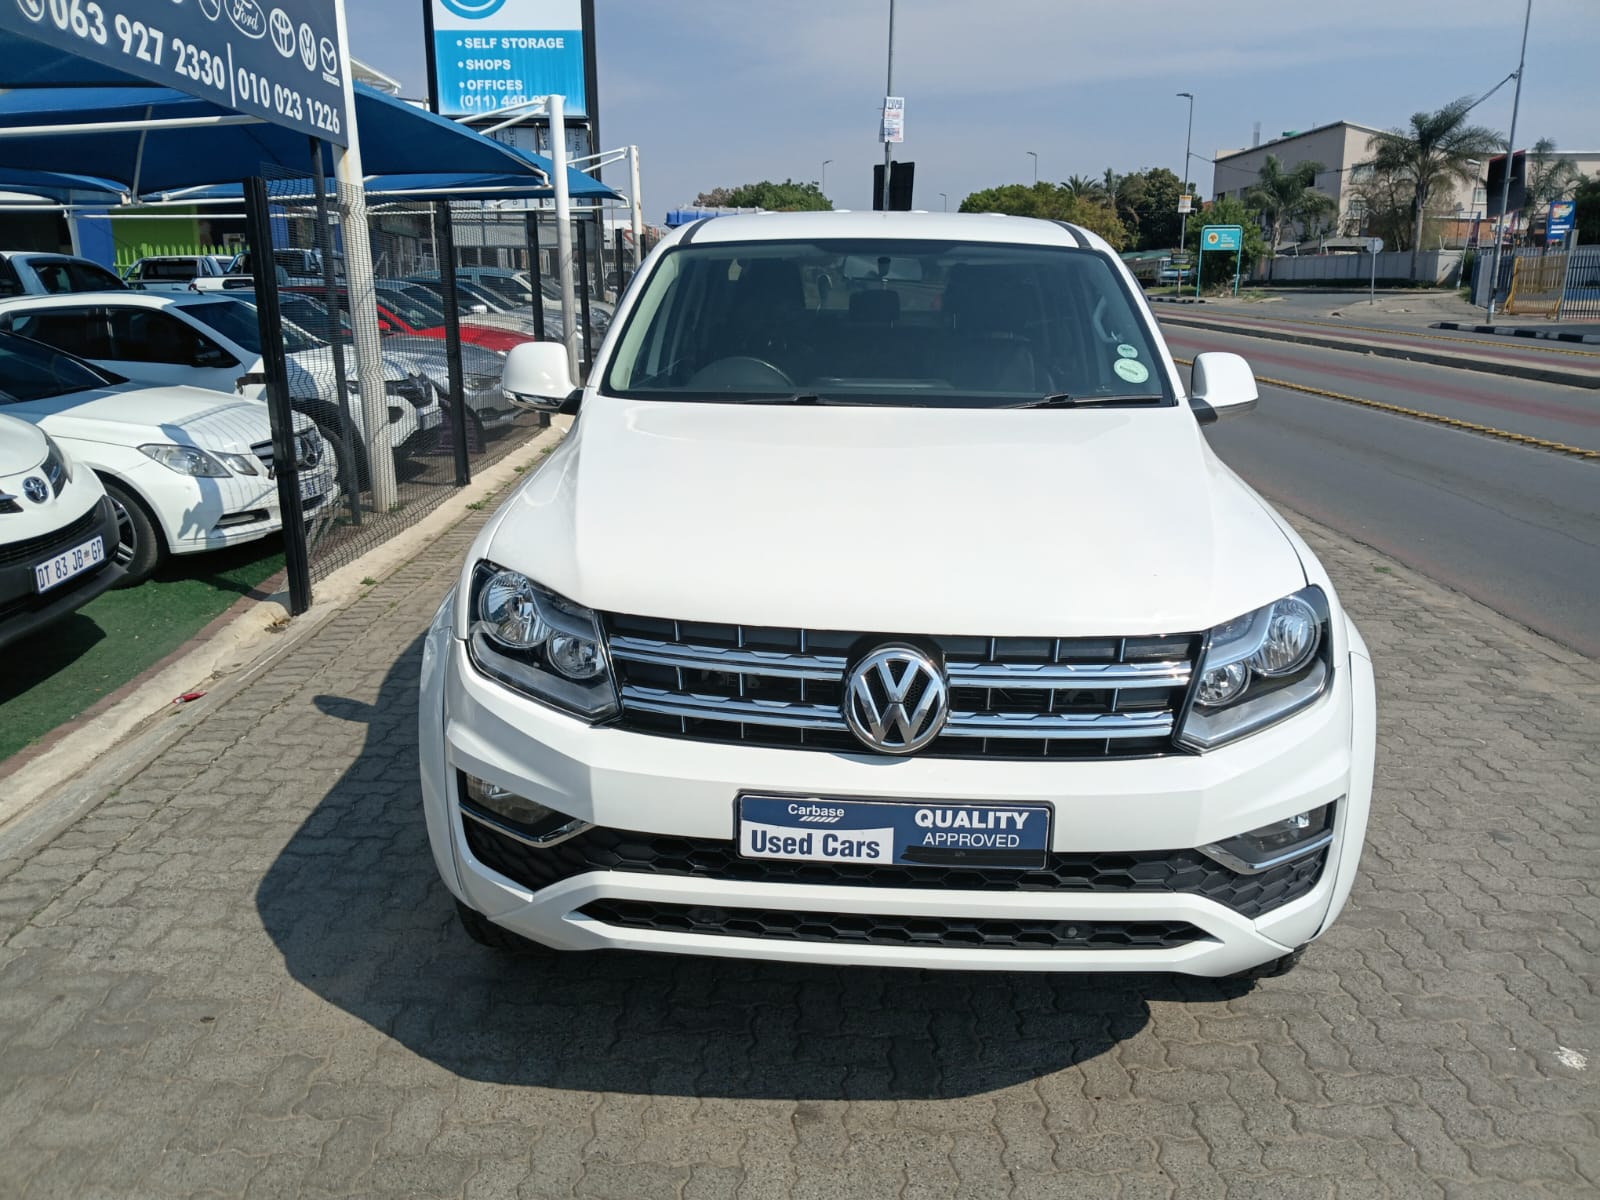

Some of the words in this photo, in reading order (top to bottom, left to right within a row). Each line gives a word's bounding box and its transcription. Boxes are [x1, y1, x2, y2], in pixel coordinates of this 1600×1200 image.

[233, 0, 259, 31] Ford
[464, 37, 497, 49] SELF
[501, 37, 565, 49] STORAGE
[50, 0, 108, 46] 063
[115, 14, 164, 65] 927
[172, 38, 225, 90] 2330
[238, 67, 270, 108] 010
[274, 83, 303, 121] 023
[306, 97, 341, 134] 1226
[466, 59, 511, 71] SHOPS
[466, 79, 523, 91] OFFICES
[460, 94, 497, 109] (011)
[38, 565, 50, 588] DT
[55, 556, 68, 579] 83
[72, 549, 84, 571] JB
[91, 539, 102, 560] GP
[787, 803, 845, 817] Carbase
[914, 808, 1030, 830] QUALITY
[751, 829, 813, 856] Used
[822, 833, 881, 859] Cars
[922, 832, 1020, 848] APPROVED
